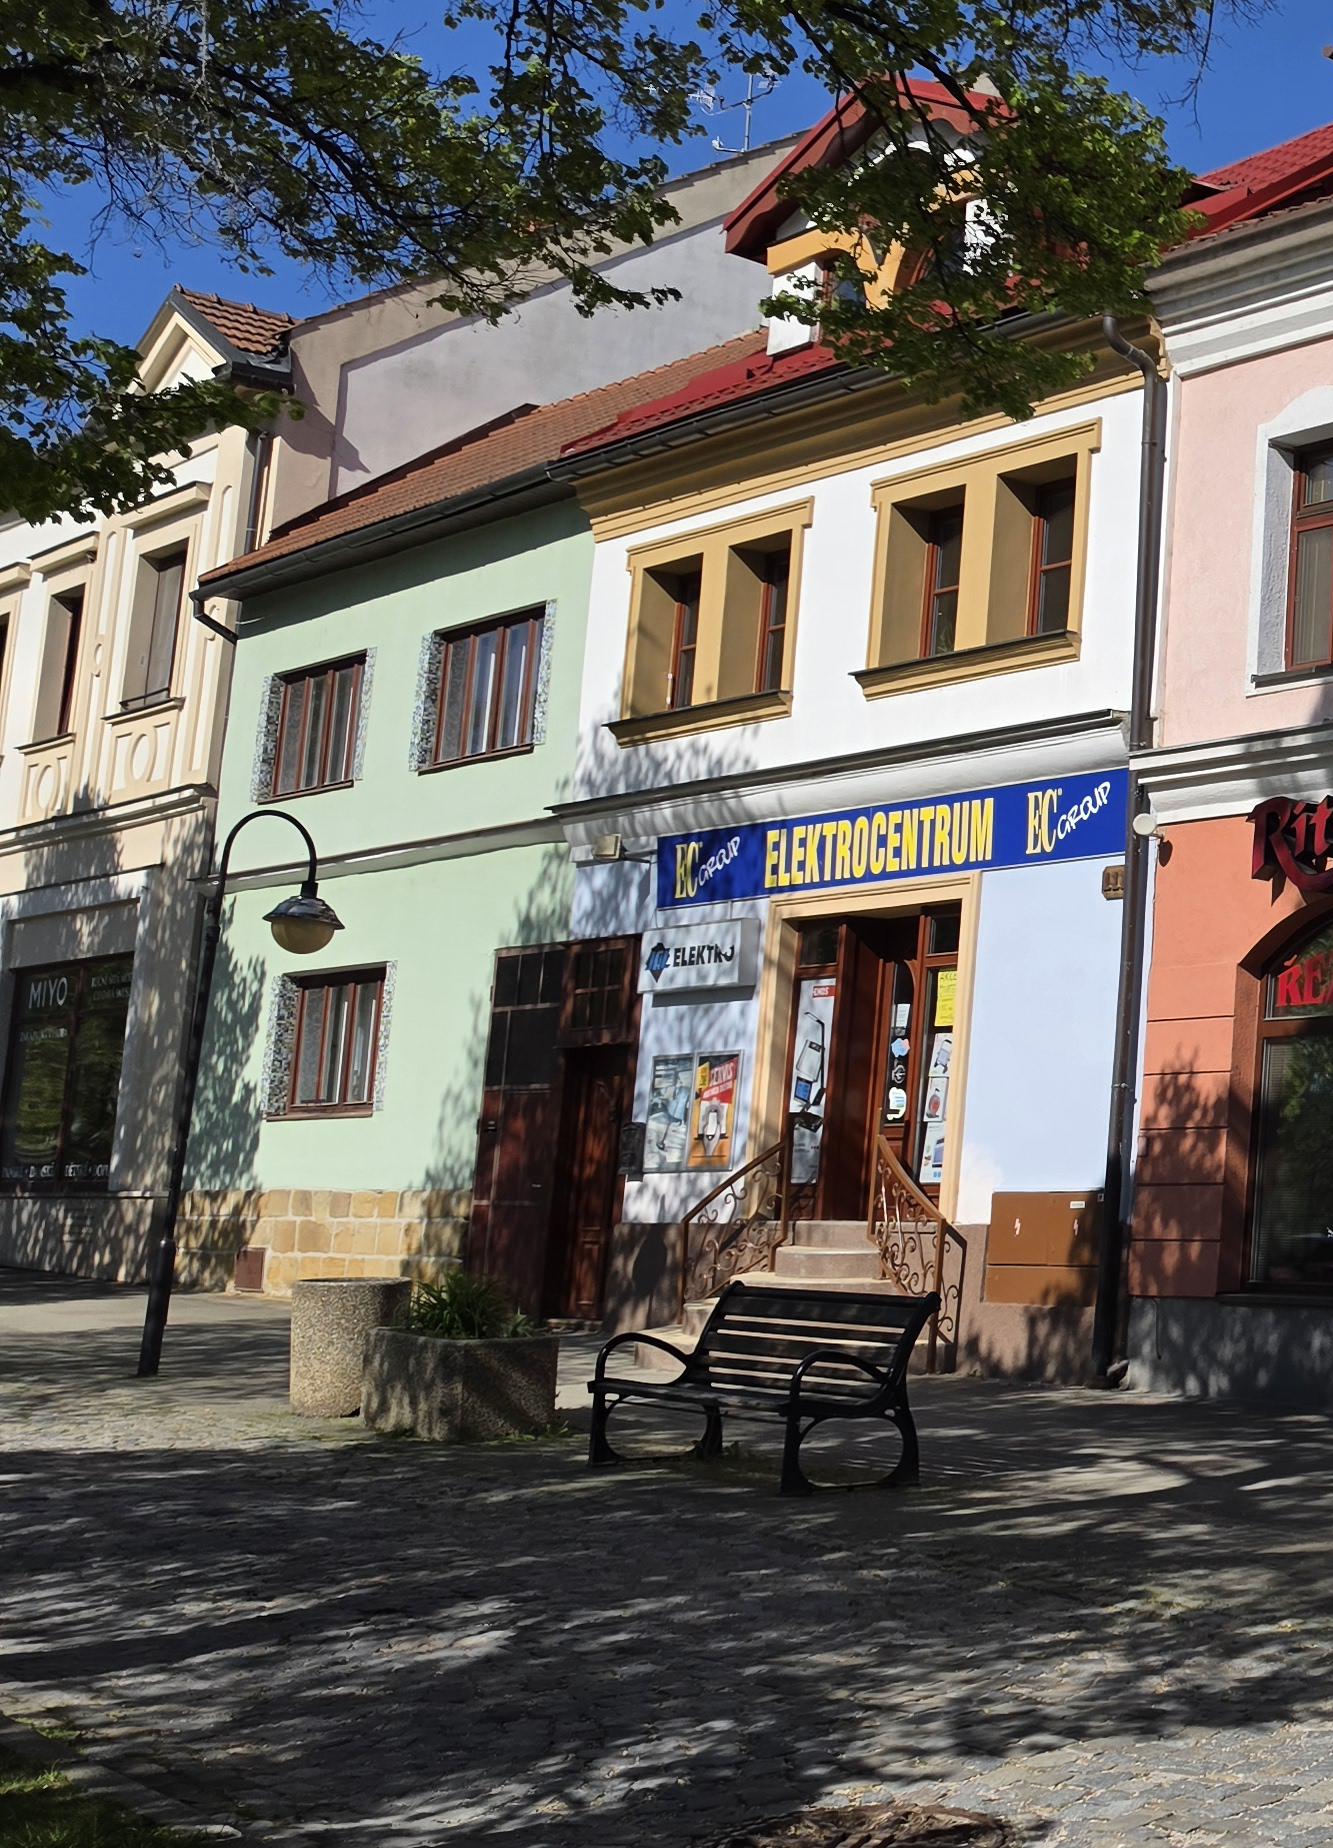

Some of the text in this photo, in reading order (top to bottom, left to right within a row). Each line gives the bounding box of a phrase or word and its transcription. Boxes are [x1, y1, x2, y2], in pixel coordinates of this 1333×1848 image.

[764, 797, 995, 889] ELEKTROCENTRUM
[1025, 781, 1112, 855] EC GROUP
[674, 841, 700, 899] EC
[29, 977, 68, 1009] MIYO
